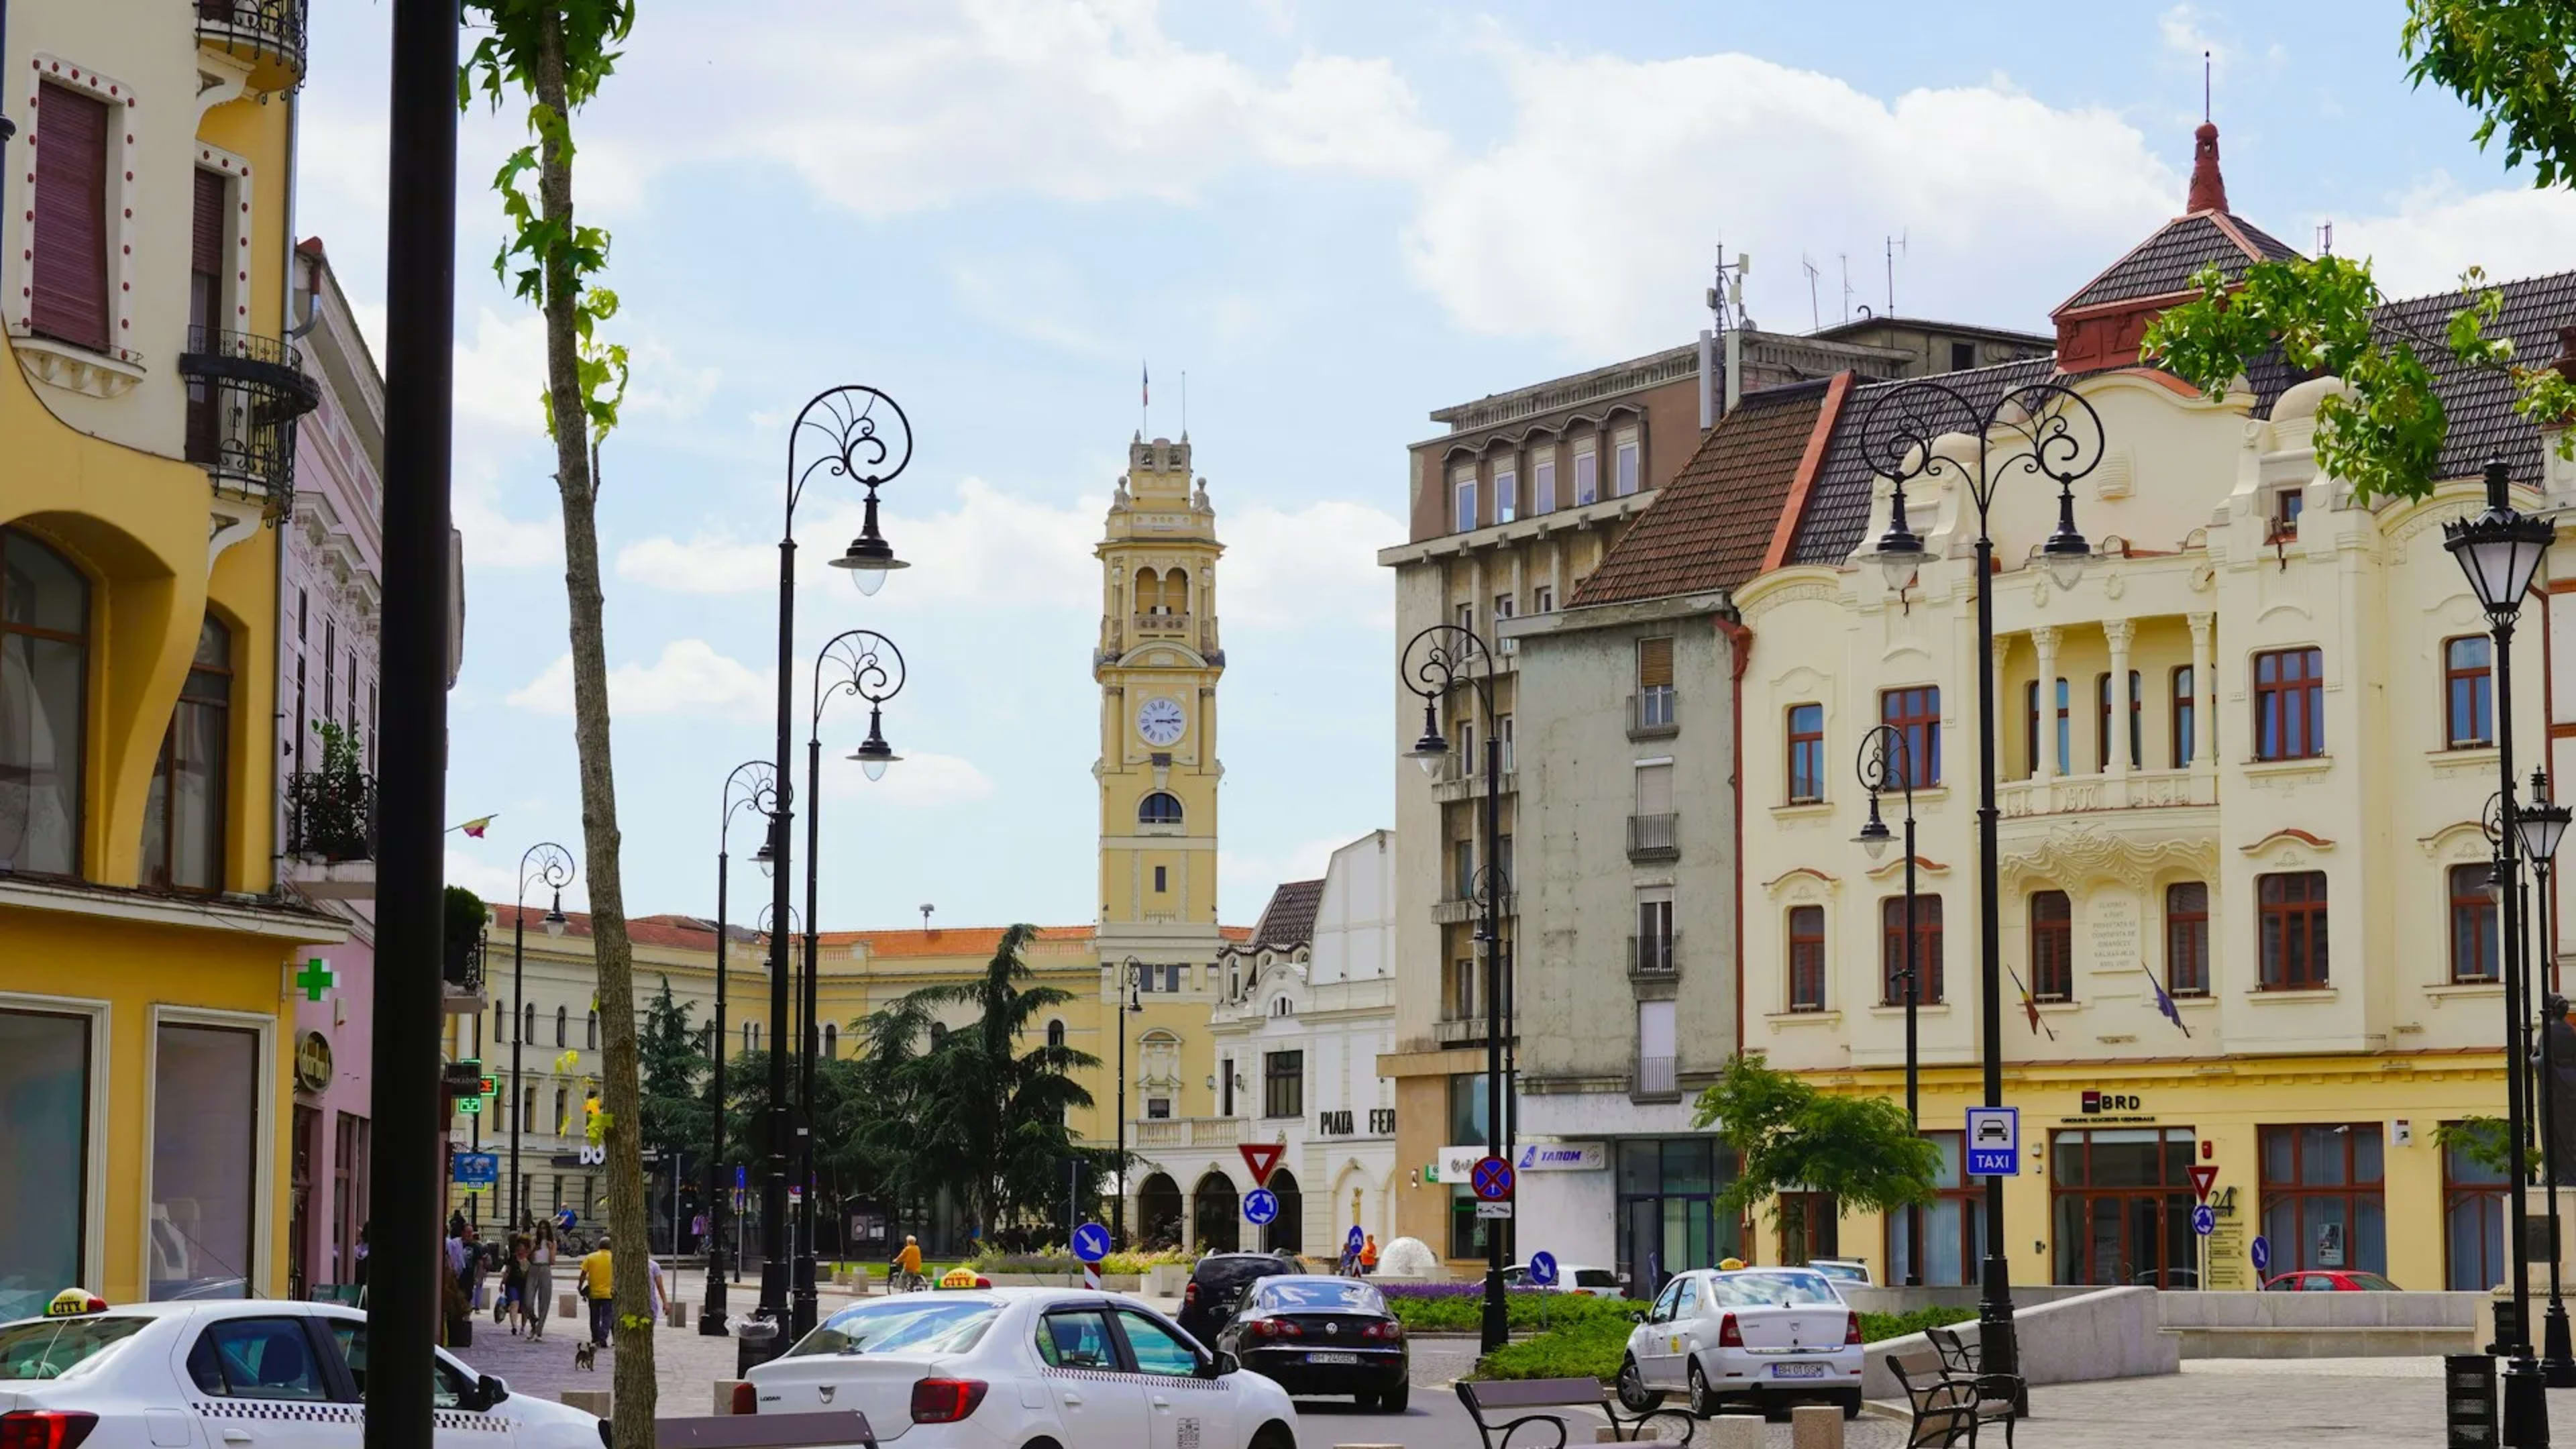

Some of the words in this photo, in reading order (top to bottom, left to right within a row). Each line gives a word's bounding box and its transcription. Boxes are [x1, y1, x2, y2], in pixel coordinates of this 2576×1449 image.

[2102, 1095, 2140, 1110] BRD
[1320, 1111, 1354, 1135] PIATA
[1542, 1151, 1582, 1161] TAROM
[1976, 1155, 2010, 1168] TAXI
[944, 1277, 971, 1286] CITY
[53, 1301, 80, 1313] CITY
[1779, 1364, 1790, 1375] BH
[1793, 1364, 1802, 1375] 01
